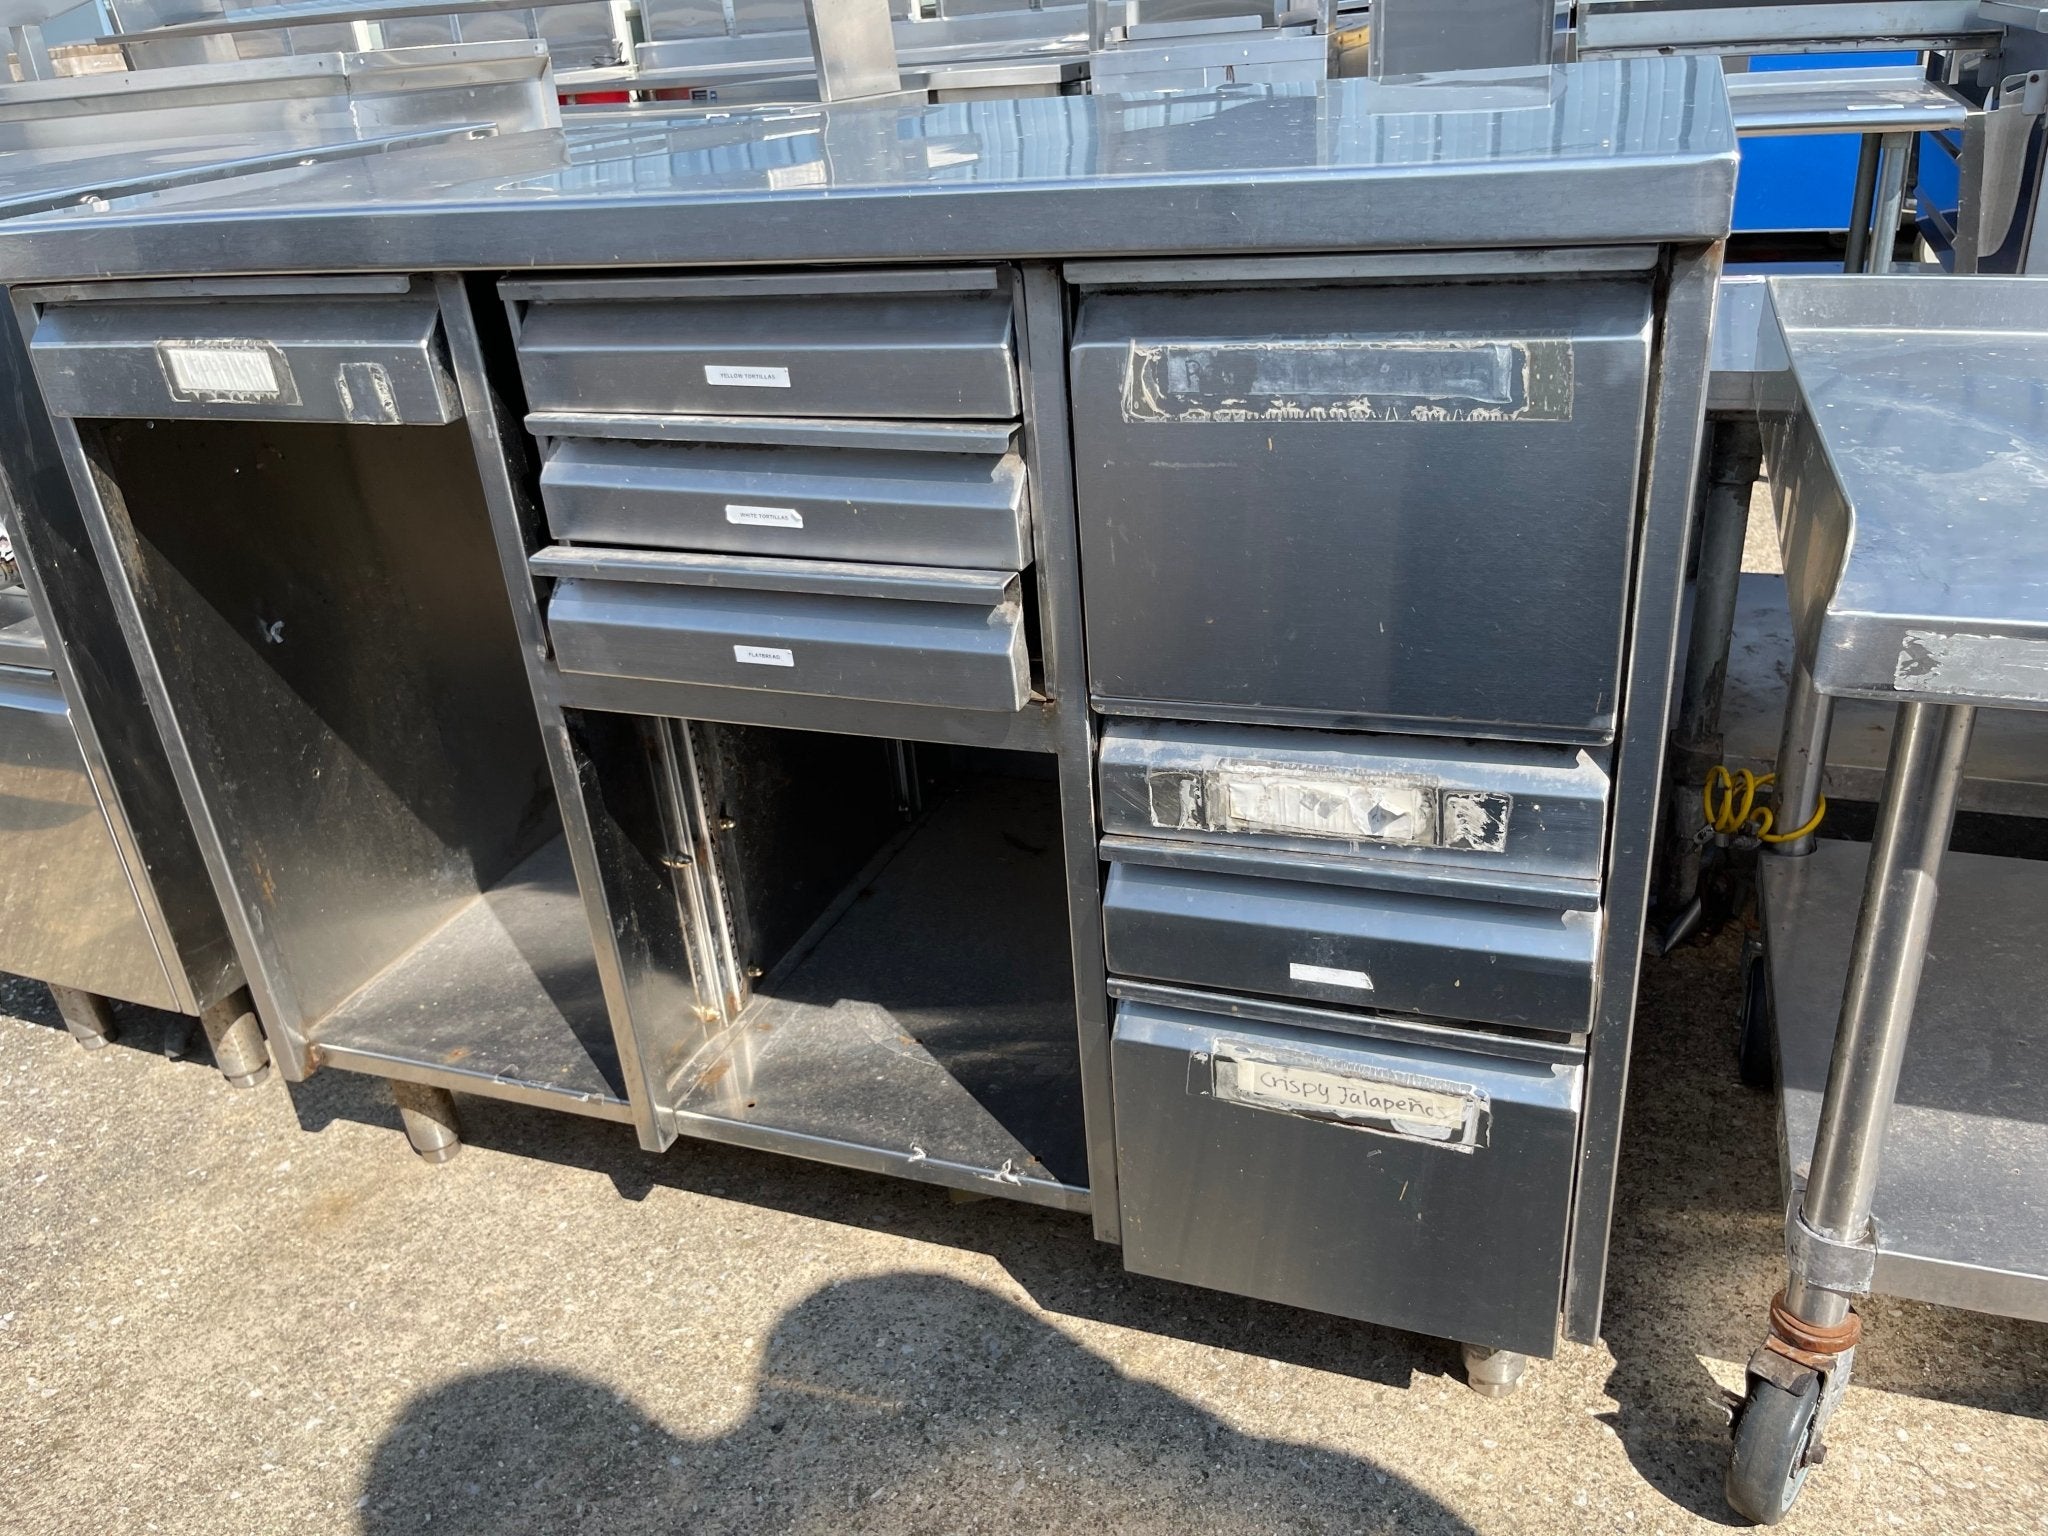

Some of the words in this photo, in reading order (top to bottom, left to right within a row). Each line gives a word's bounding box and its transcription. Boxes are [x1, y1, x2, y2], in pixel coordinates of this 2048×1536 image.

[758, 513, 789, 521] TORTILLAS
[748, 652, 781, 660] FLATBREAD
[1260, 1071, 1330, 1105] Crispy
